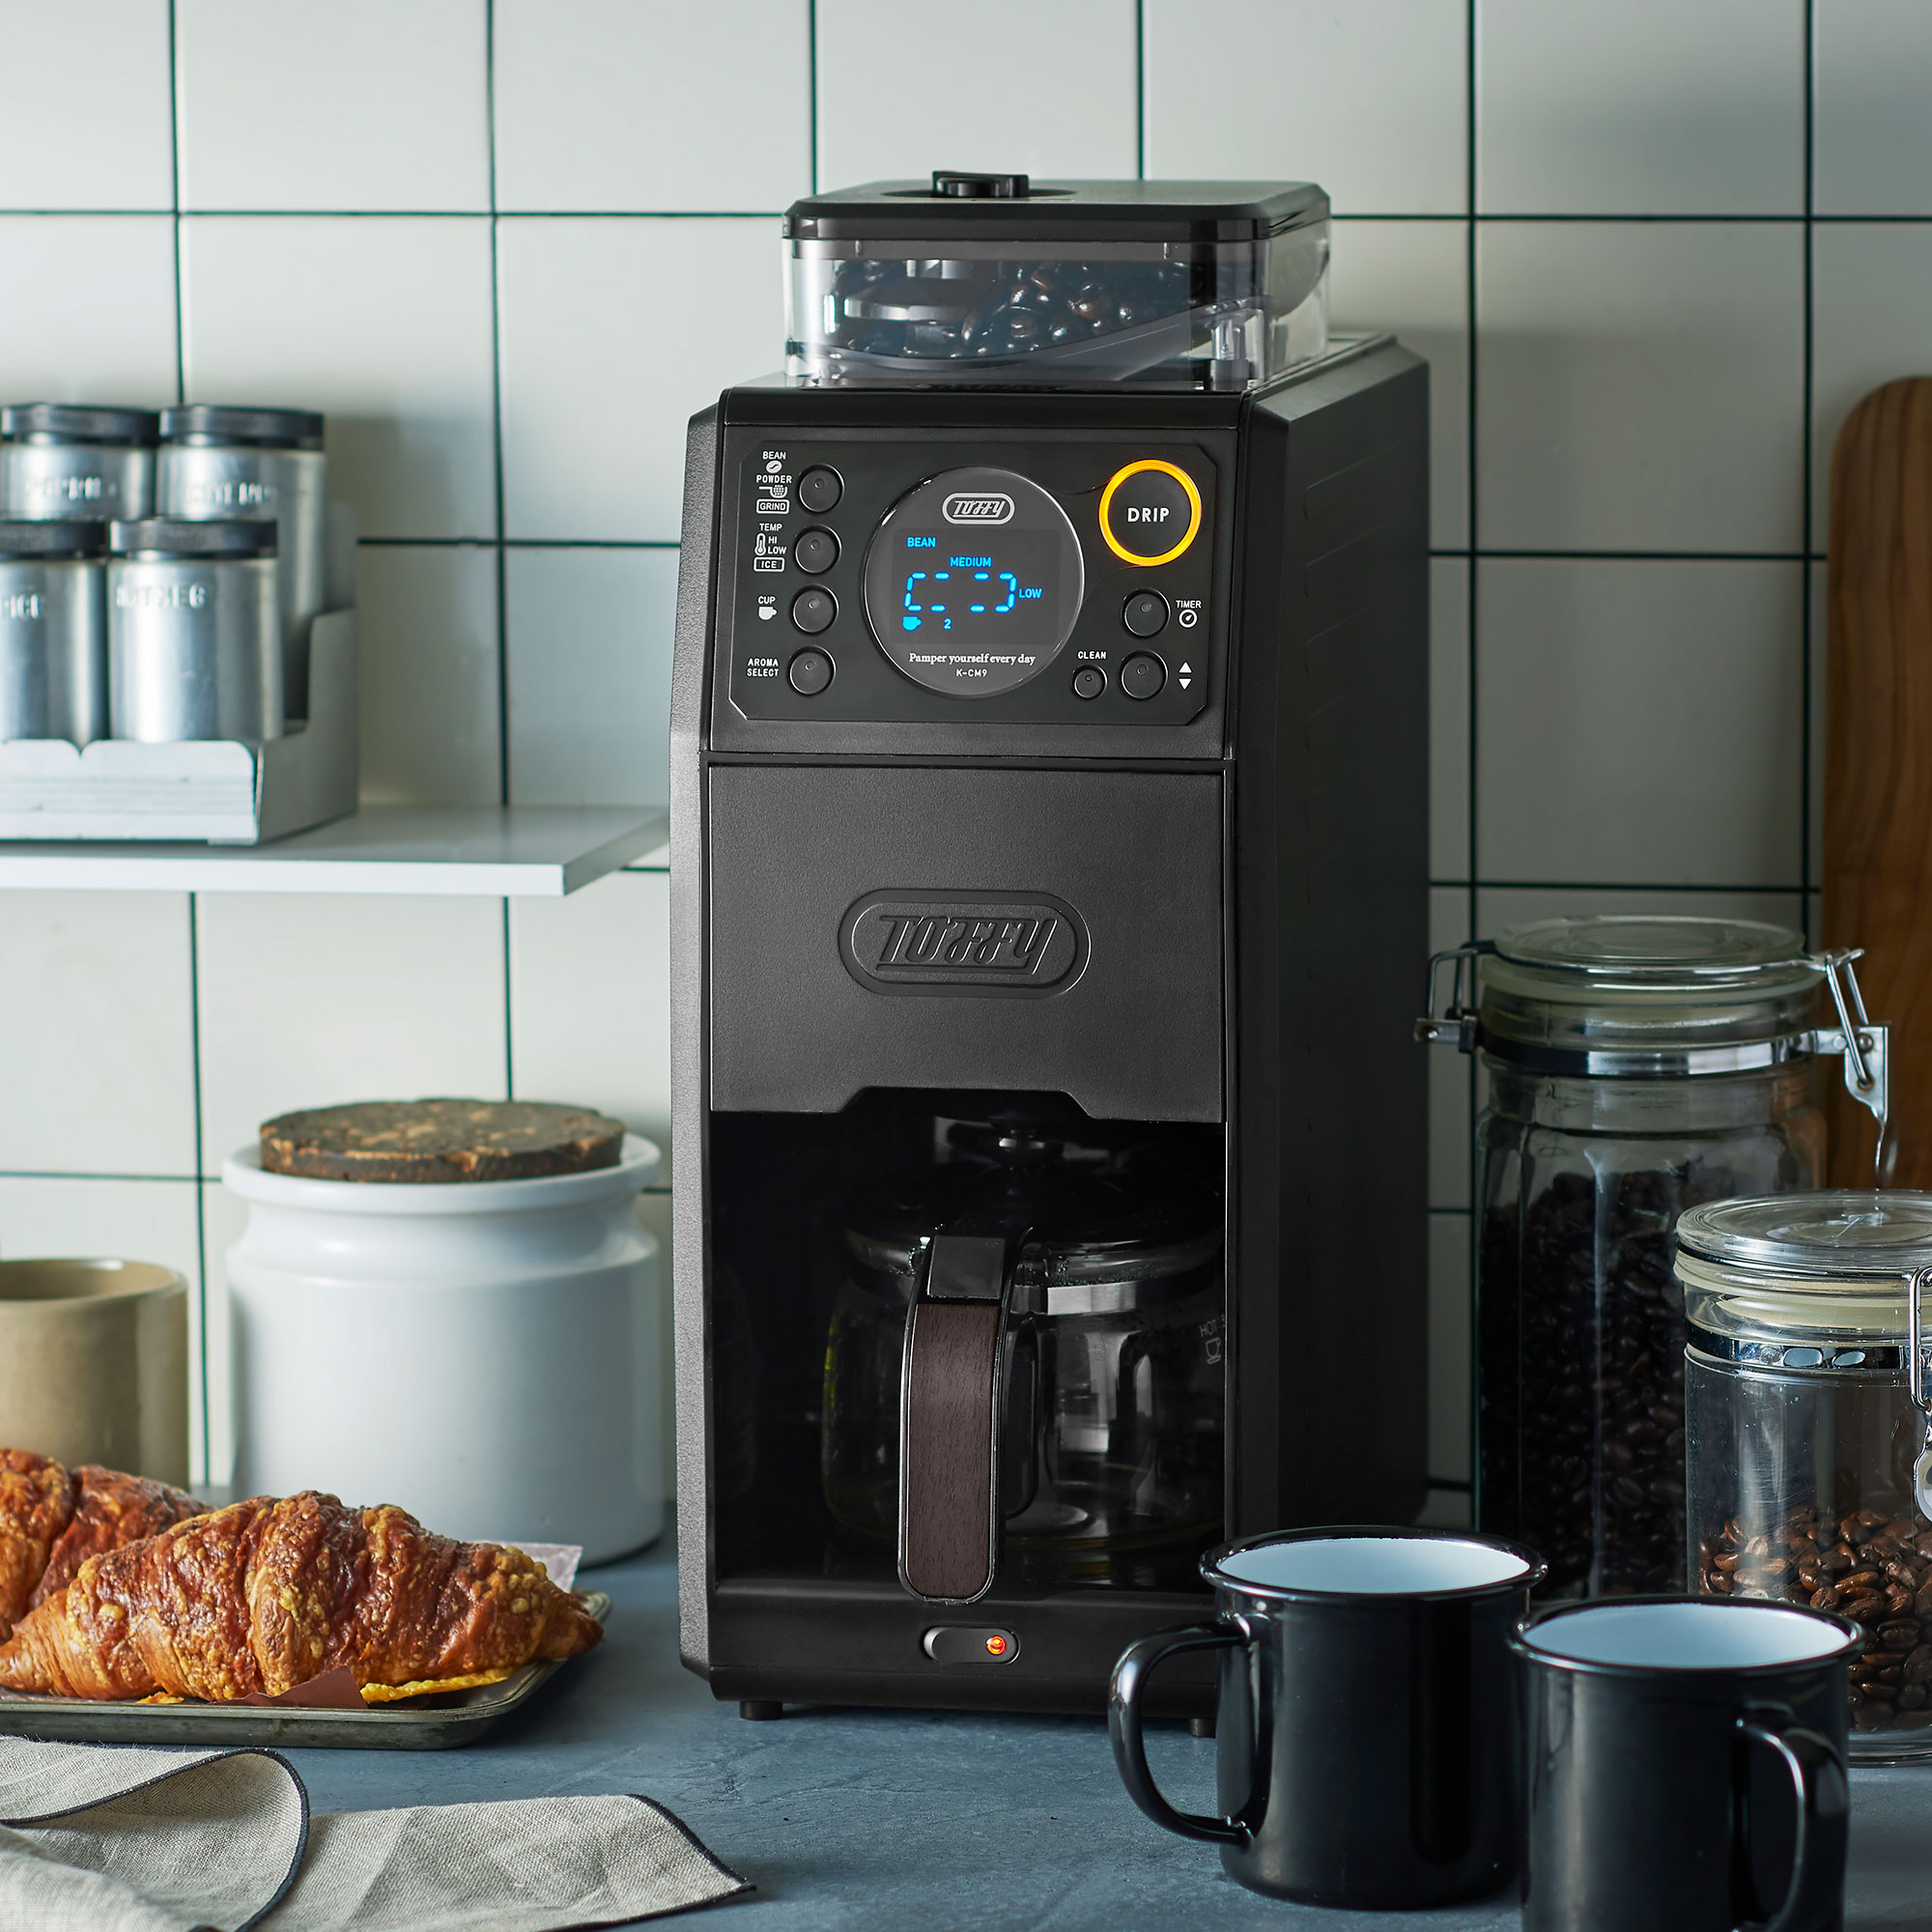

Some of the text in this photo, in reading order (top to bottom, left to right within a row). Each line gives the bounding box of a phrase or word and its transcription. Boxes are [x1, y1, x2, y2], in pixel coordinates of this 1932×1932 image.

[762, 450, 786, 460] BEAN
[756, 473, 792, 484] POWDER
[759, 502, 786, 512] GRIND
[952, 499, 1006, 518] TOFFY
[1128, 507, 1169, 523] DRIP
[759, 523, 782, 532] TEMP
[768, 535, 778, 545] HI
[907, 537, 936, 548] BEAN
[767, 546, 787, 555] LOW
[761, 560, 777, 570] ICE
[950, 556, 992, 567] MEDIUM
[1019, 587, 1043, 600] LOW
[758, 595, 777, 605] CUP
[1176, 599, 1202, 610] TIMER
[944, 617, 952, 630] 2
[909, 652, 1037, 667] Pamper yourself every day
[1078, 650, 1107, 660] CLEAN
[748, 657, 779, 667] AROMA
[746, 668, 780, 678] SELECT
[955, 668, 987, 677] K-CM9
[876, 915, 1059, 976] TOFFY
[1199, 1320, 1218, 1338] HOT
